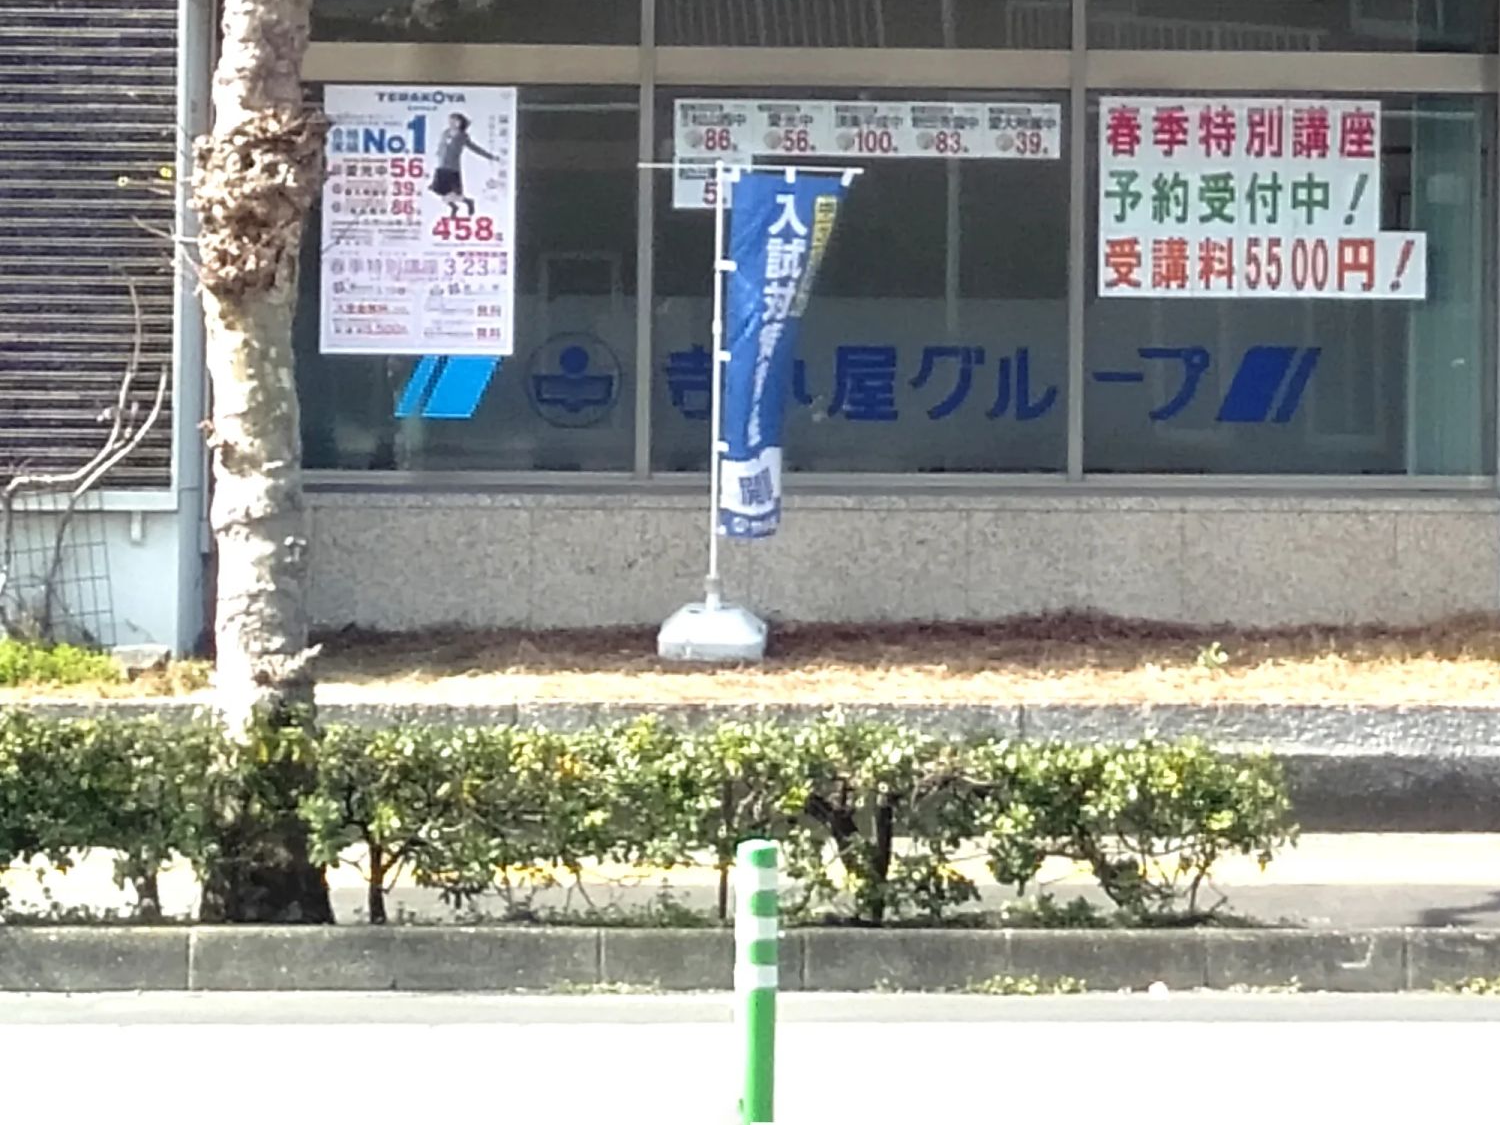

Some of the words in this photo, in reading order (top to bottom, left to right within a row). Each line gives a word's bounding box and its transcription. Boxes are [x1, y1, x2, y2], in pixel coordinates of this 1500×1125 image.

[1105, 104, 1376, 160] 春季特別講座
[1104, 169, 1369, 225] 予約受付中!
[664, 341, 1210, 423] 寺屋グループ
